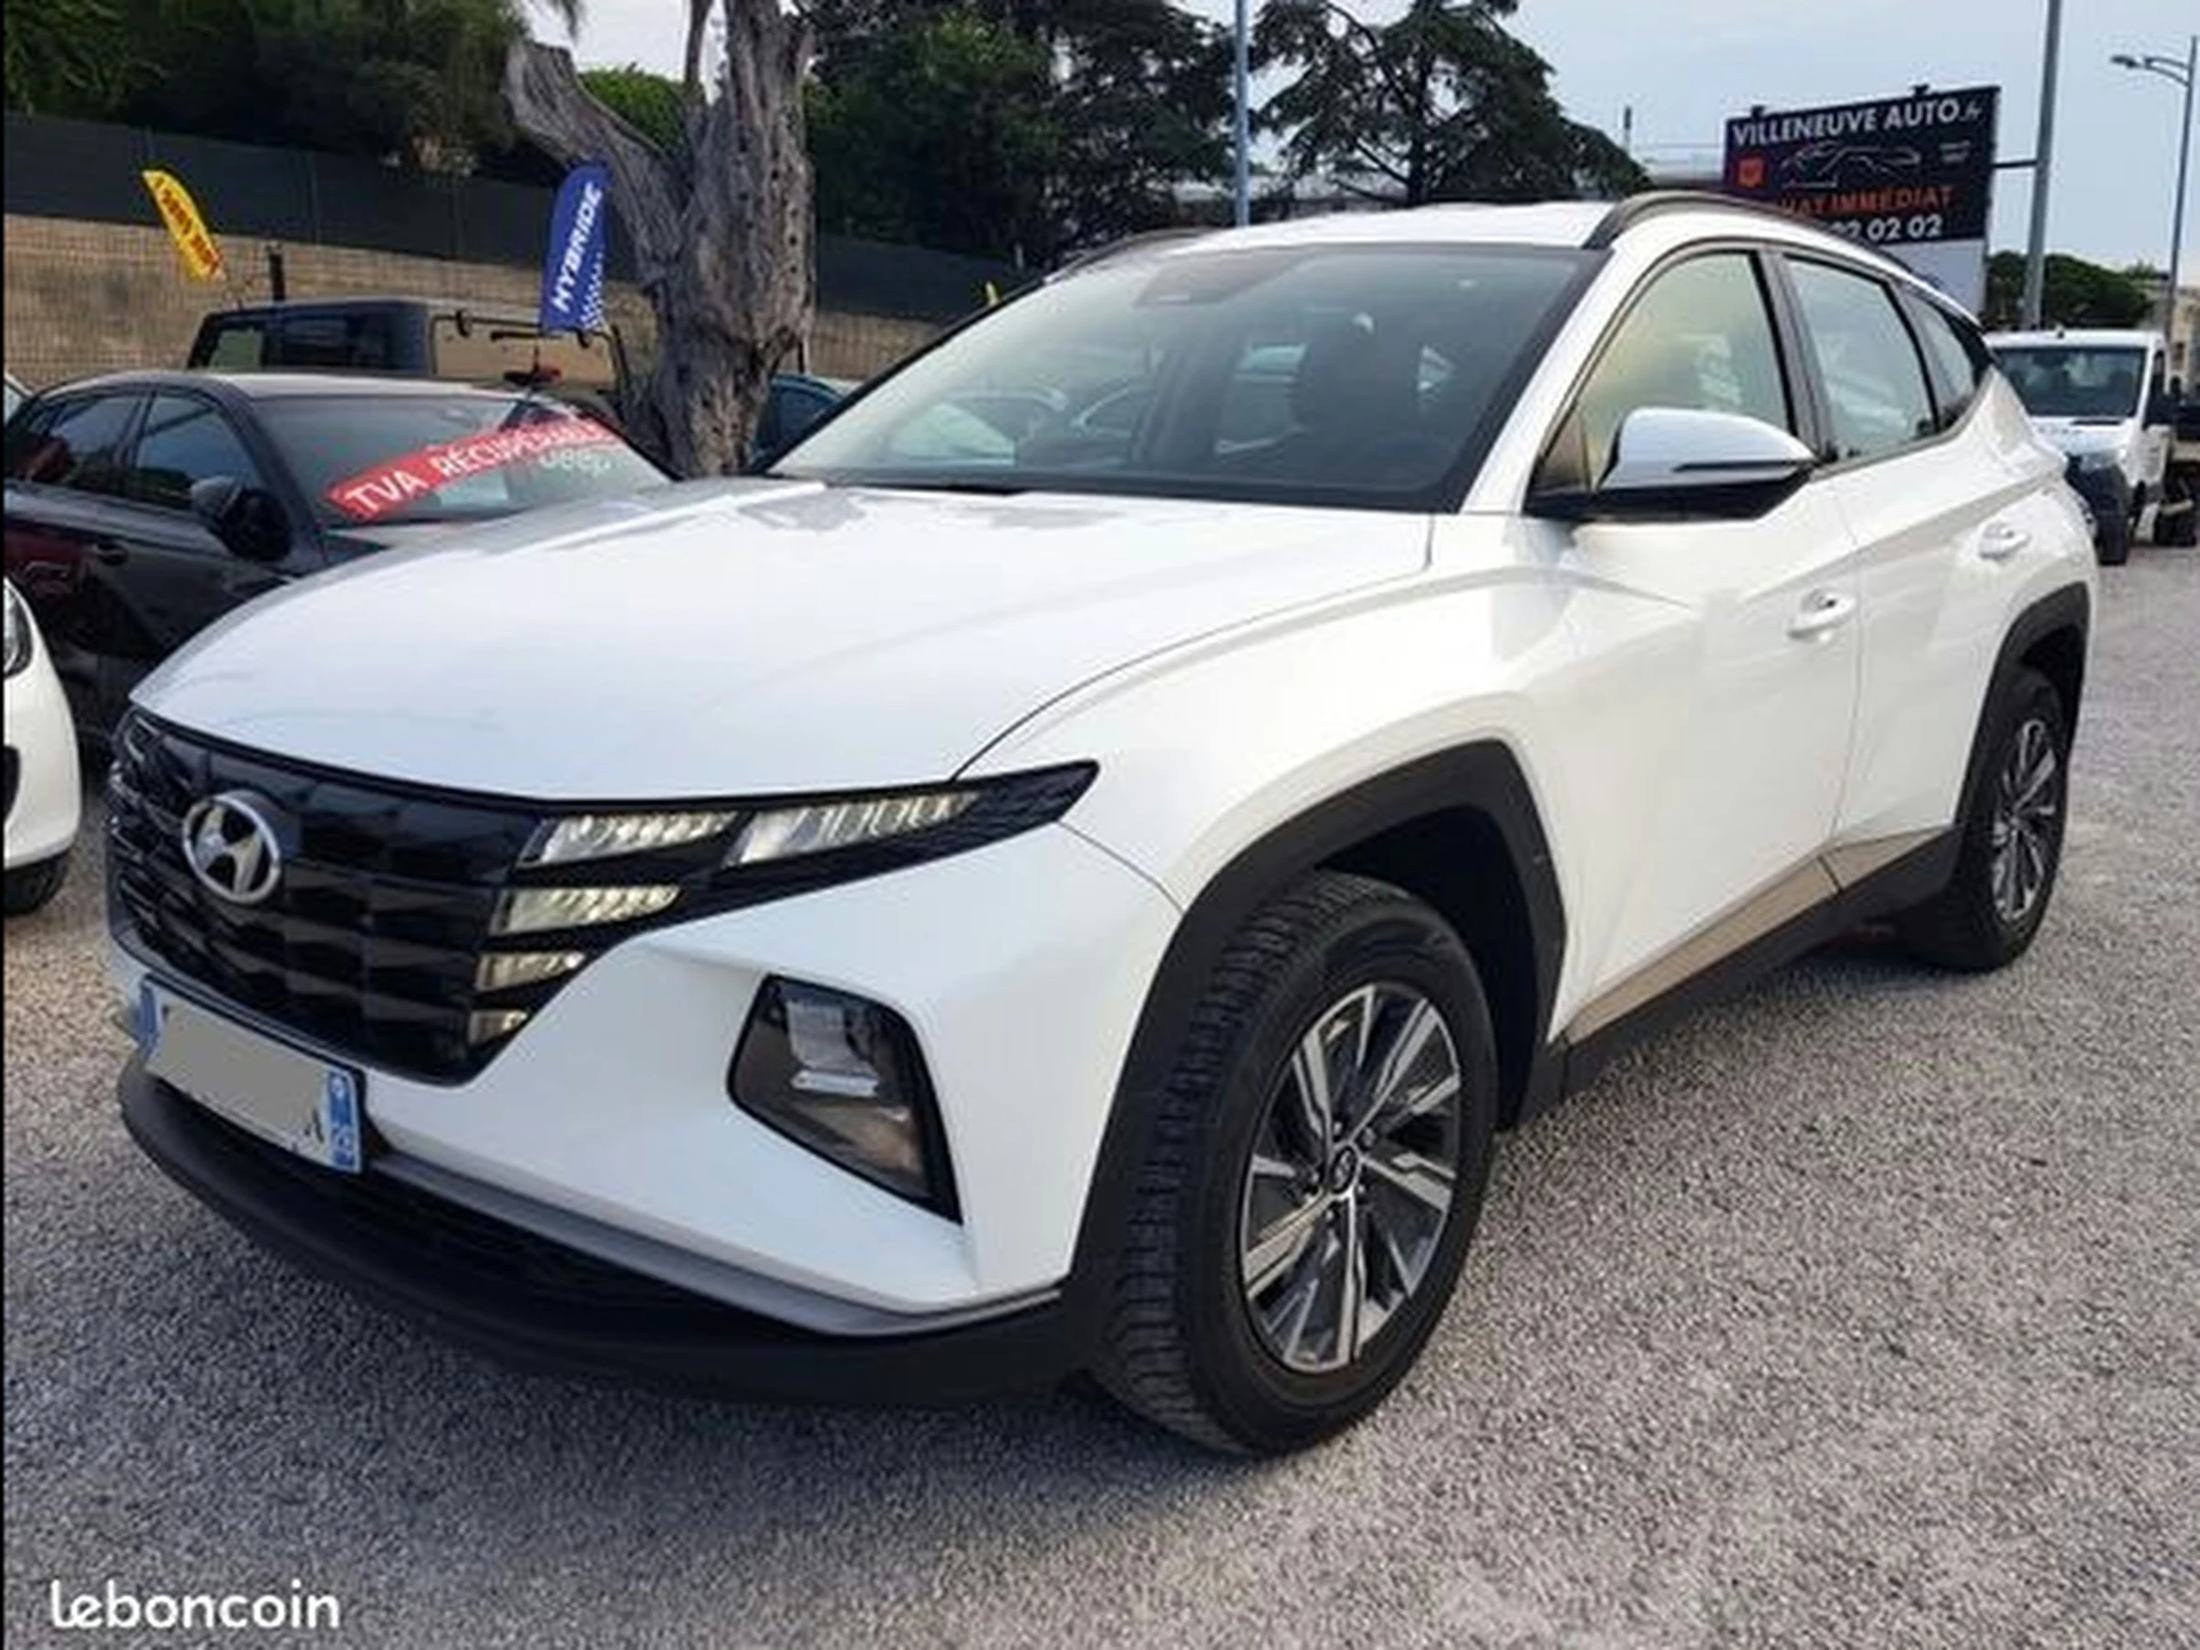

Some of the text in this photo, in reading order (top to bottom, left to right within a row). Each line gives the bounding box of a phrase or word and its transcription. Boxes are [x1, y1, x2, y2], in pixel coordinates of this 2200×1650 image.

[1731, 107, 1877, 147] VILLENEUVE
[551, 180, 603, 314] HYBRIDE
[1866, 218, 1901, 241] 02
[1906, 214, 1943, 239] 02
[344, 468, 429, 513] TVA
